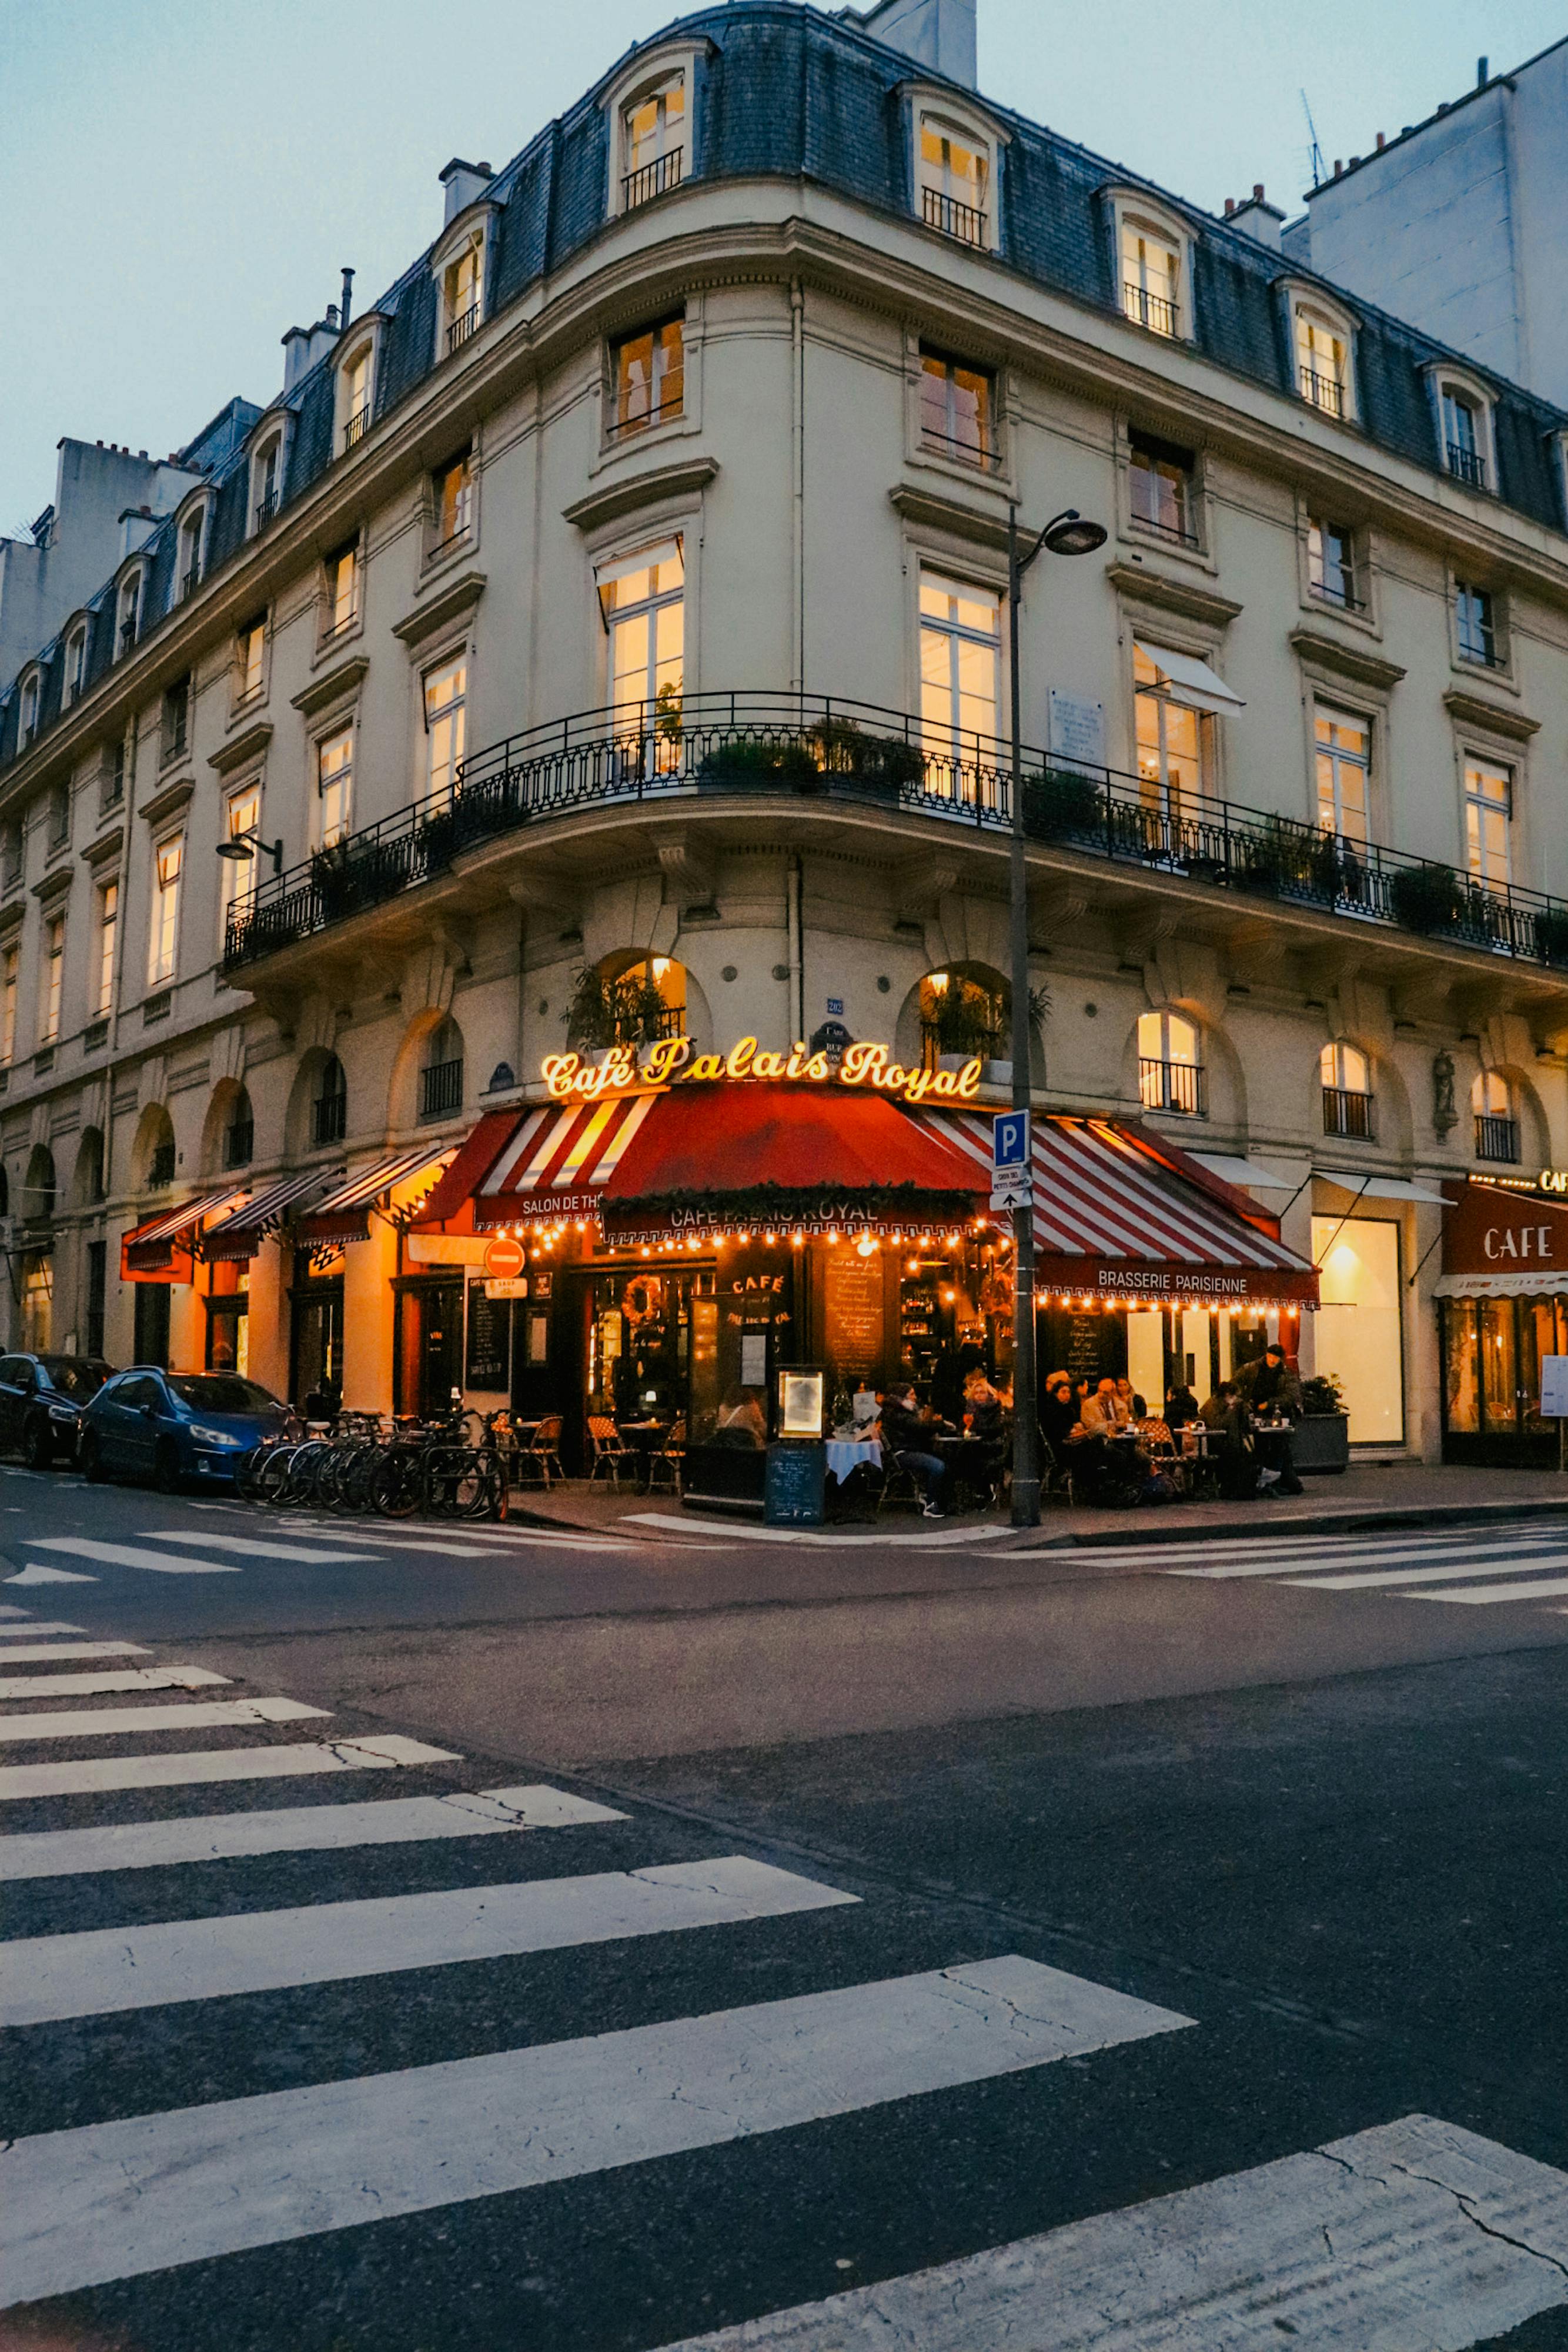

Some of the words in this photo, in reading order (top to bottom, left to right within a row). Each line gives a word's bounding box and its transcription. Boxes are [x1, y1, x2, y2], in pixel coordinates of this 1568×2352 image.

[828, 1002, 842, 1013] 202
[541, 1048, 634, 1099] Café
[643, 1036, 829, 1084] Palais
[840, 1043, 982, 1100] Royal
[1003, 1124, 1017, 1157] P
[523, 1197, 560, 1214] SALON
[563, 1196, 579, 1210] DE
[1485, 1226, 1553, 1259] CAFE
[733, 1275, 784, 1294] CAFÉ
[1098, 1270, 1171, 1289] BRASSERIE
[1176, 1275, 1247, 1293] PARISIENNE
